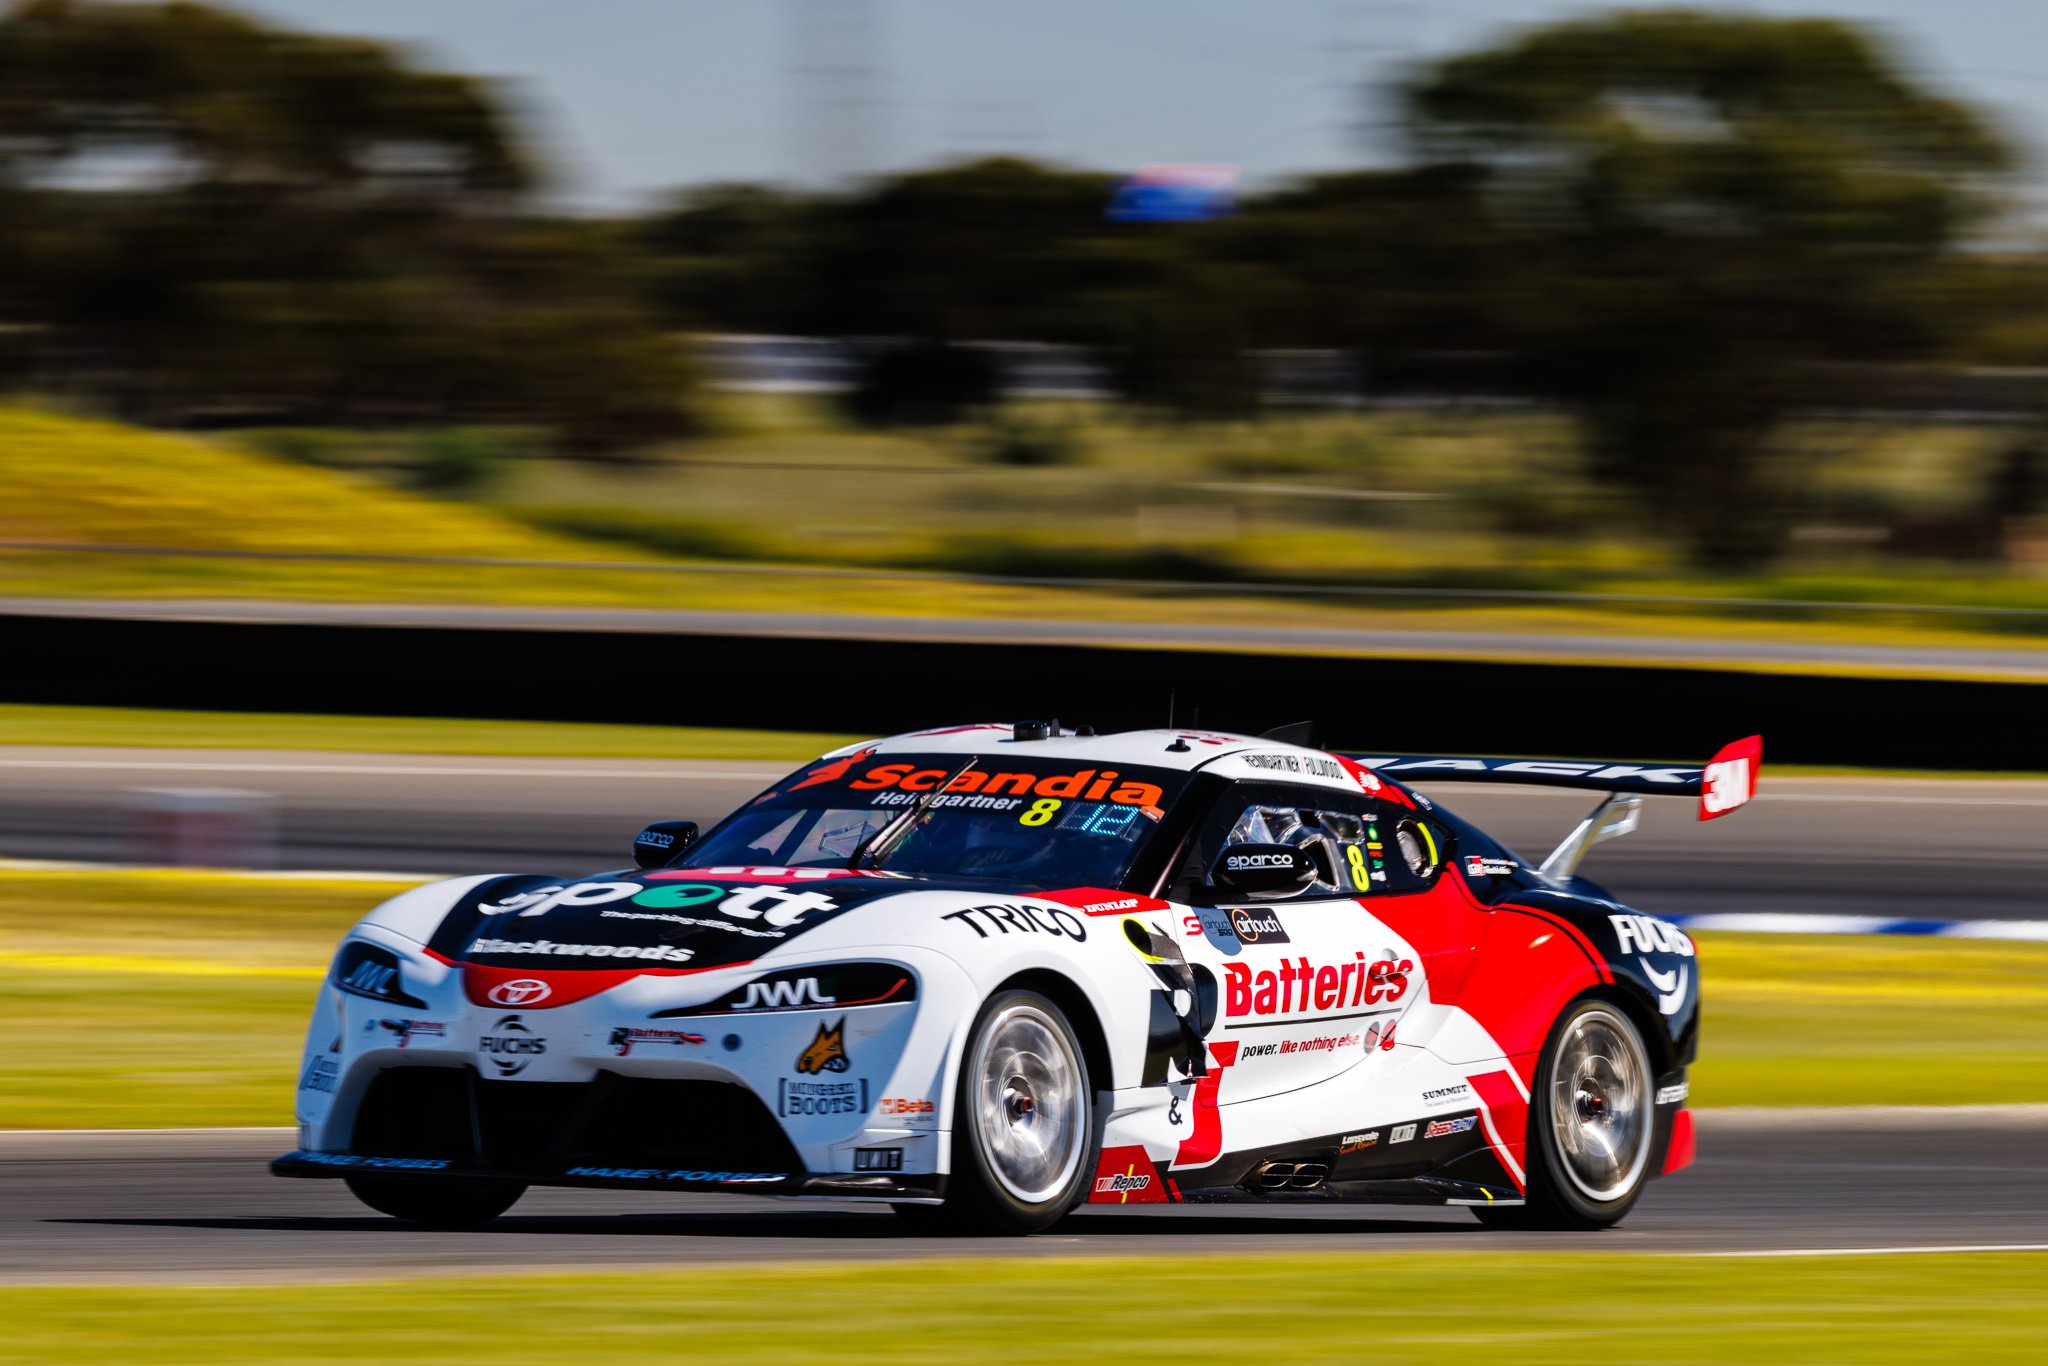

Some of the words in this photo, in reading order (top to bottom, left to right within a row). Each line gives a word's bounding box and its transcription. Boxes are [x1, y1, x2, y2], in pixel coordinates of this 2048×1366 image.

[848, 763, 1164, 808] Scandia
[1018, 798, 1062, 827] 8
[1226, 854, 1294, 871] sparco
[1346, 845, 1370, 892] 8
[1083, 898, 1139, 912] DUNLOP
[940, 904, 1087, 943] TRICO
[1236, 914, 1282, 933] airtouch
[730, 977, 837, 1009] JWL
[1221, 951, 1414, 1017] Batteries
[479, 1036, 547, 1055] FUCHS
[1241, 1042, 1278, 1060] power.
[1279, 1040, 1297, 1054] like
[1298, 1036, 1335, 1052] nothing
[1422, 1084, 1467, 1100] SUMMIT
[896, 1099, 935, 1114] Beta
[1168, 1096, 1183, 1126] &
[1110, 1174, 1150, 1193] Repco
